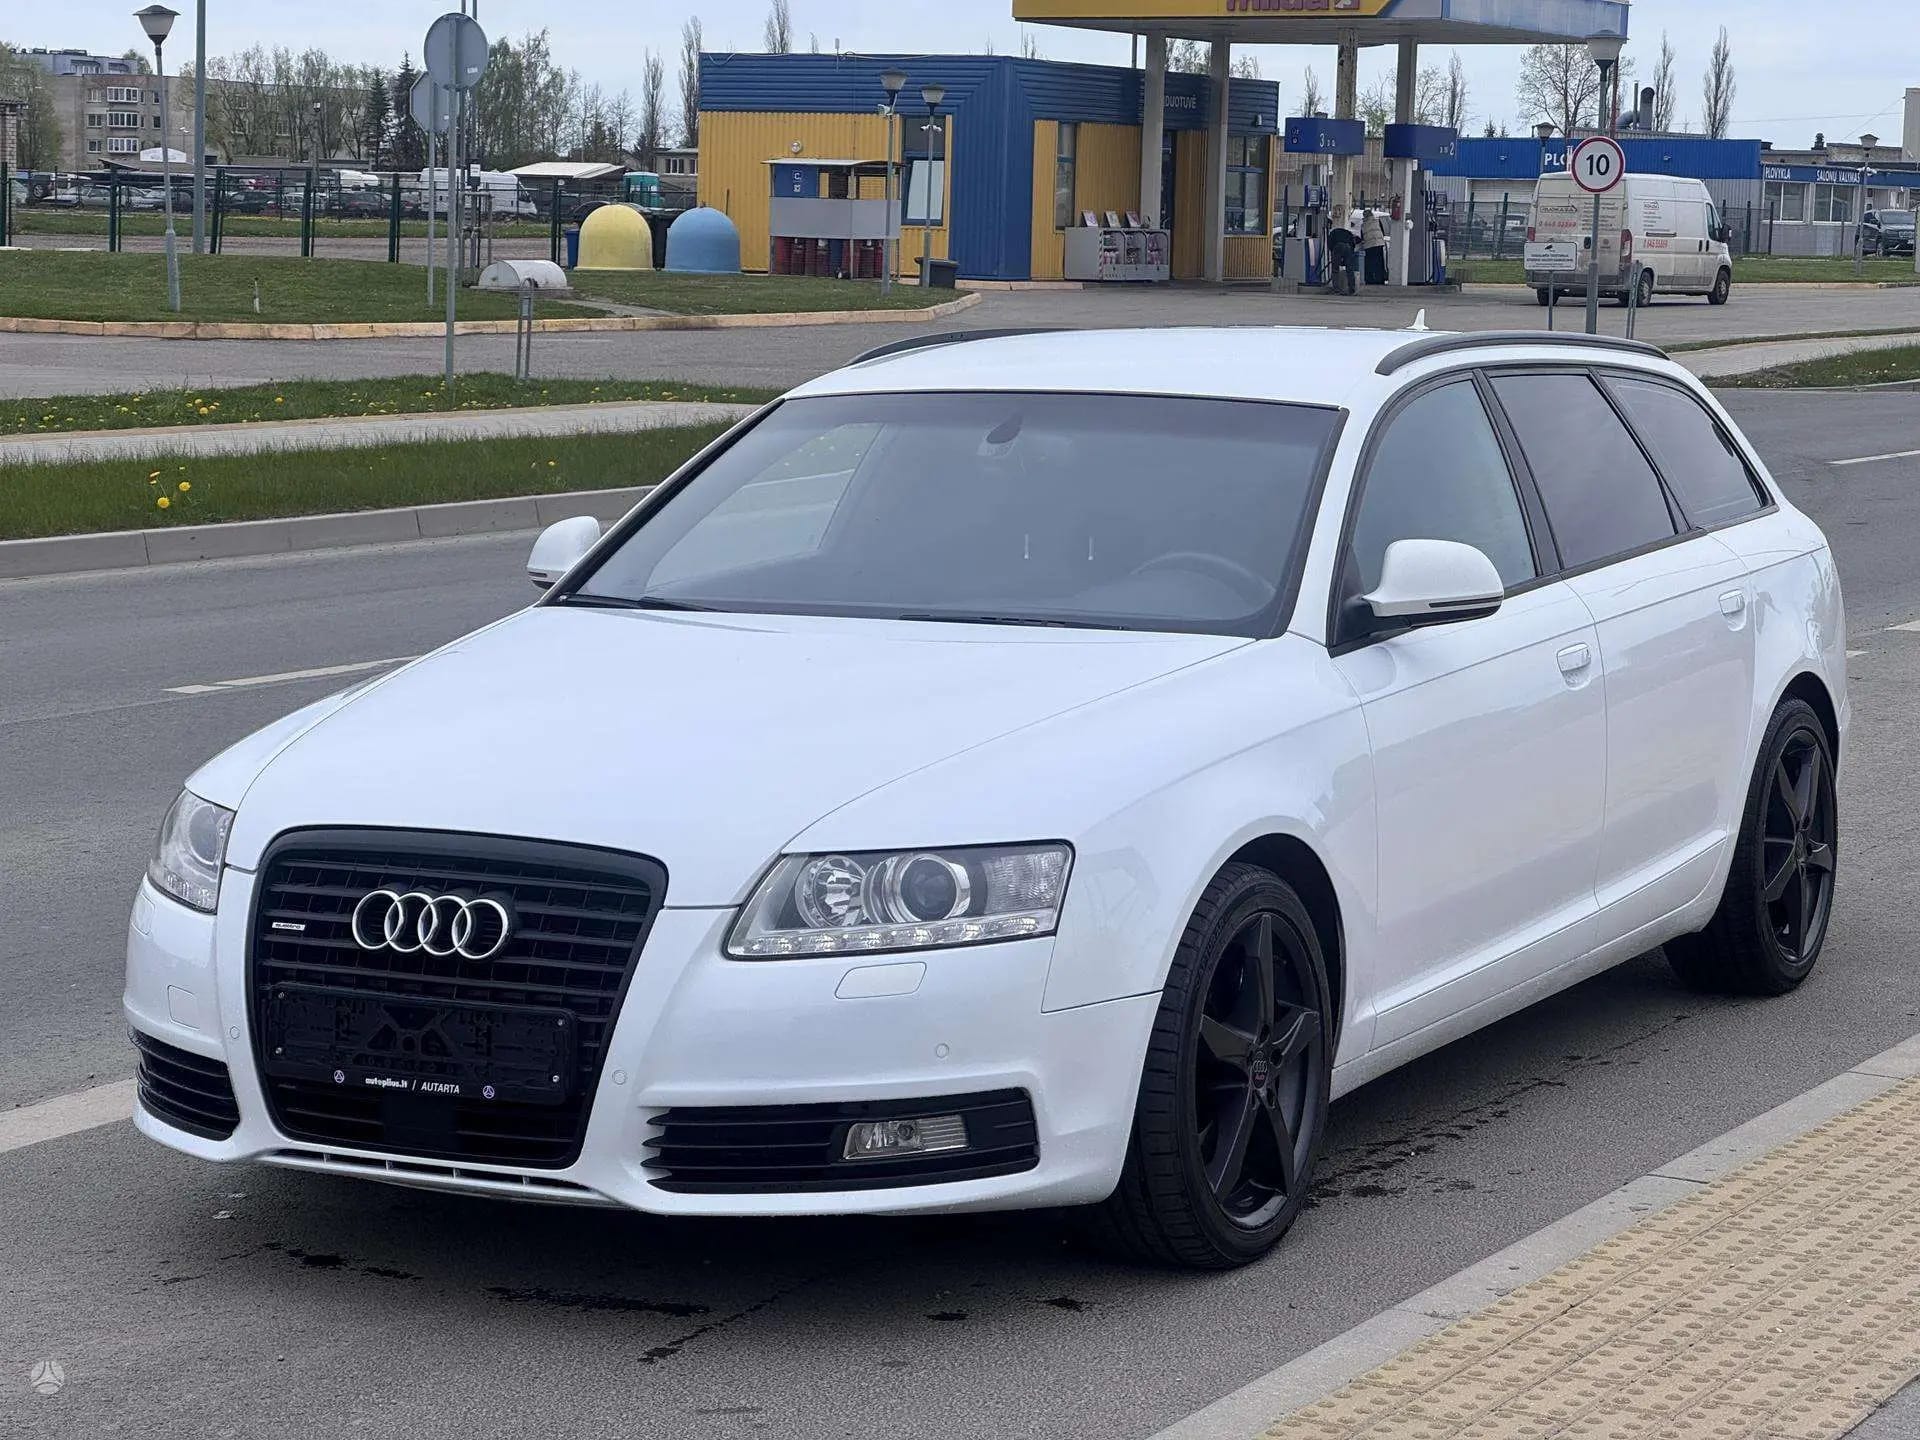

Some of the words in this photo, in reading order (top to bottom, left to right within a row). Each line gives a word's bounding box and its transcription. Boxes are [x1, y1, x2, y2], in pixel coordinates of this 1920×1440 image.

[1586, 153, 1610, 176] 10
[1765, 167, 1791, 180] PLOVYKLA
[420, 1082, 460, 1094] AUTARTA
